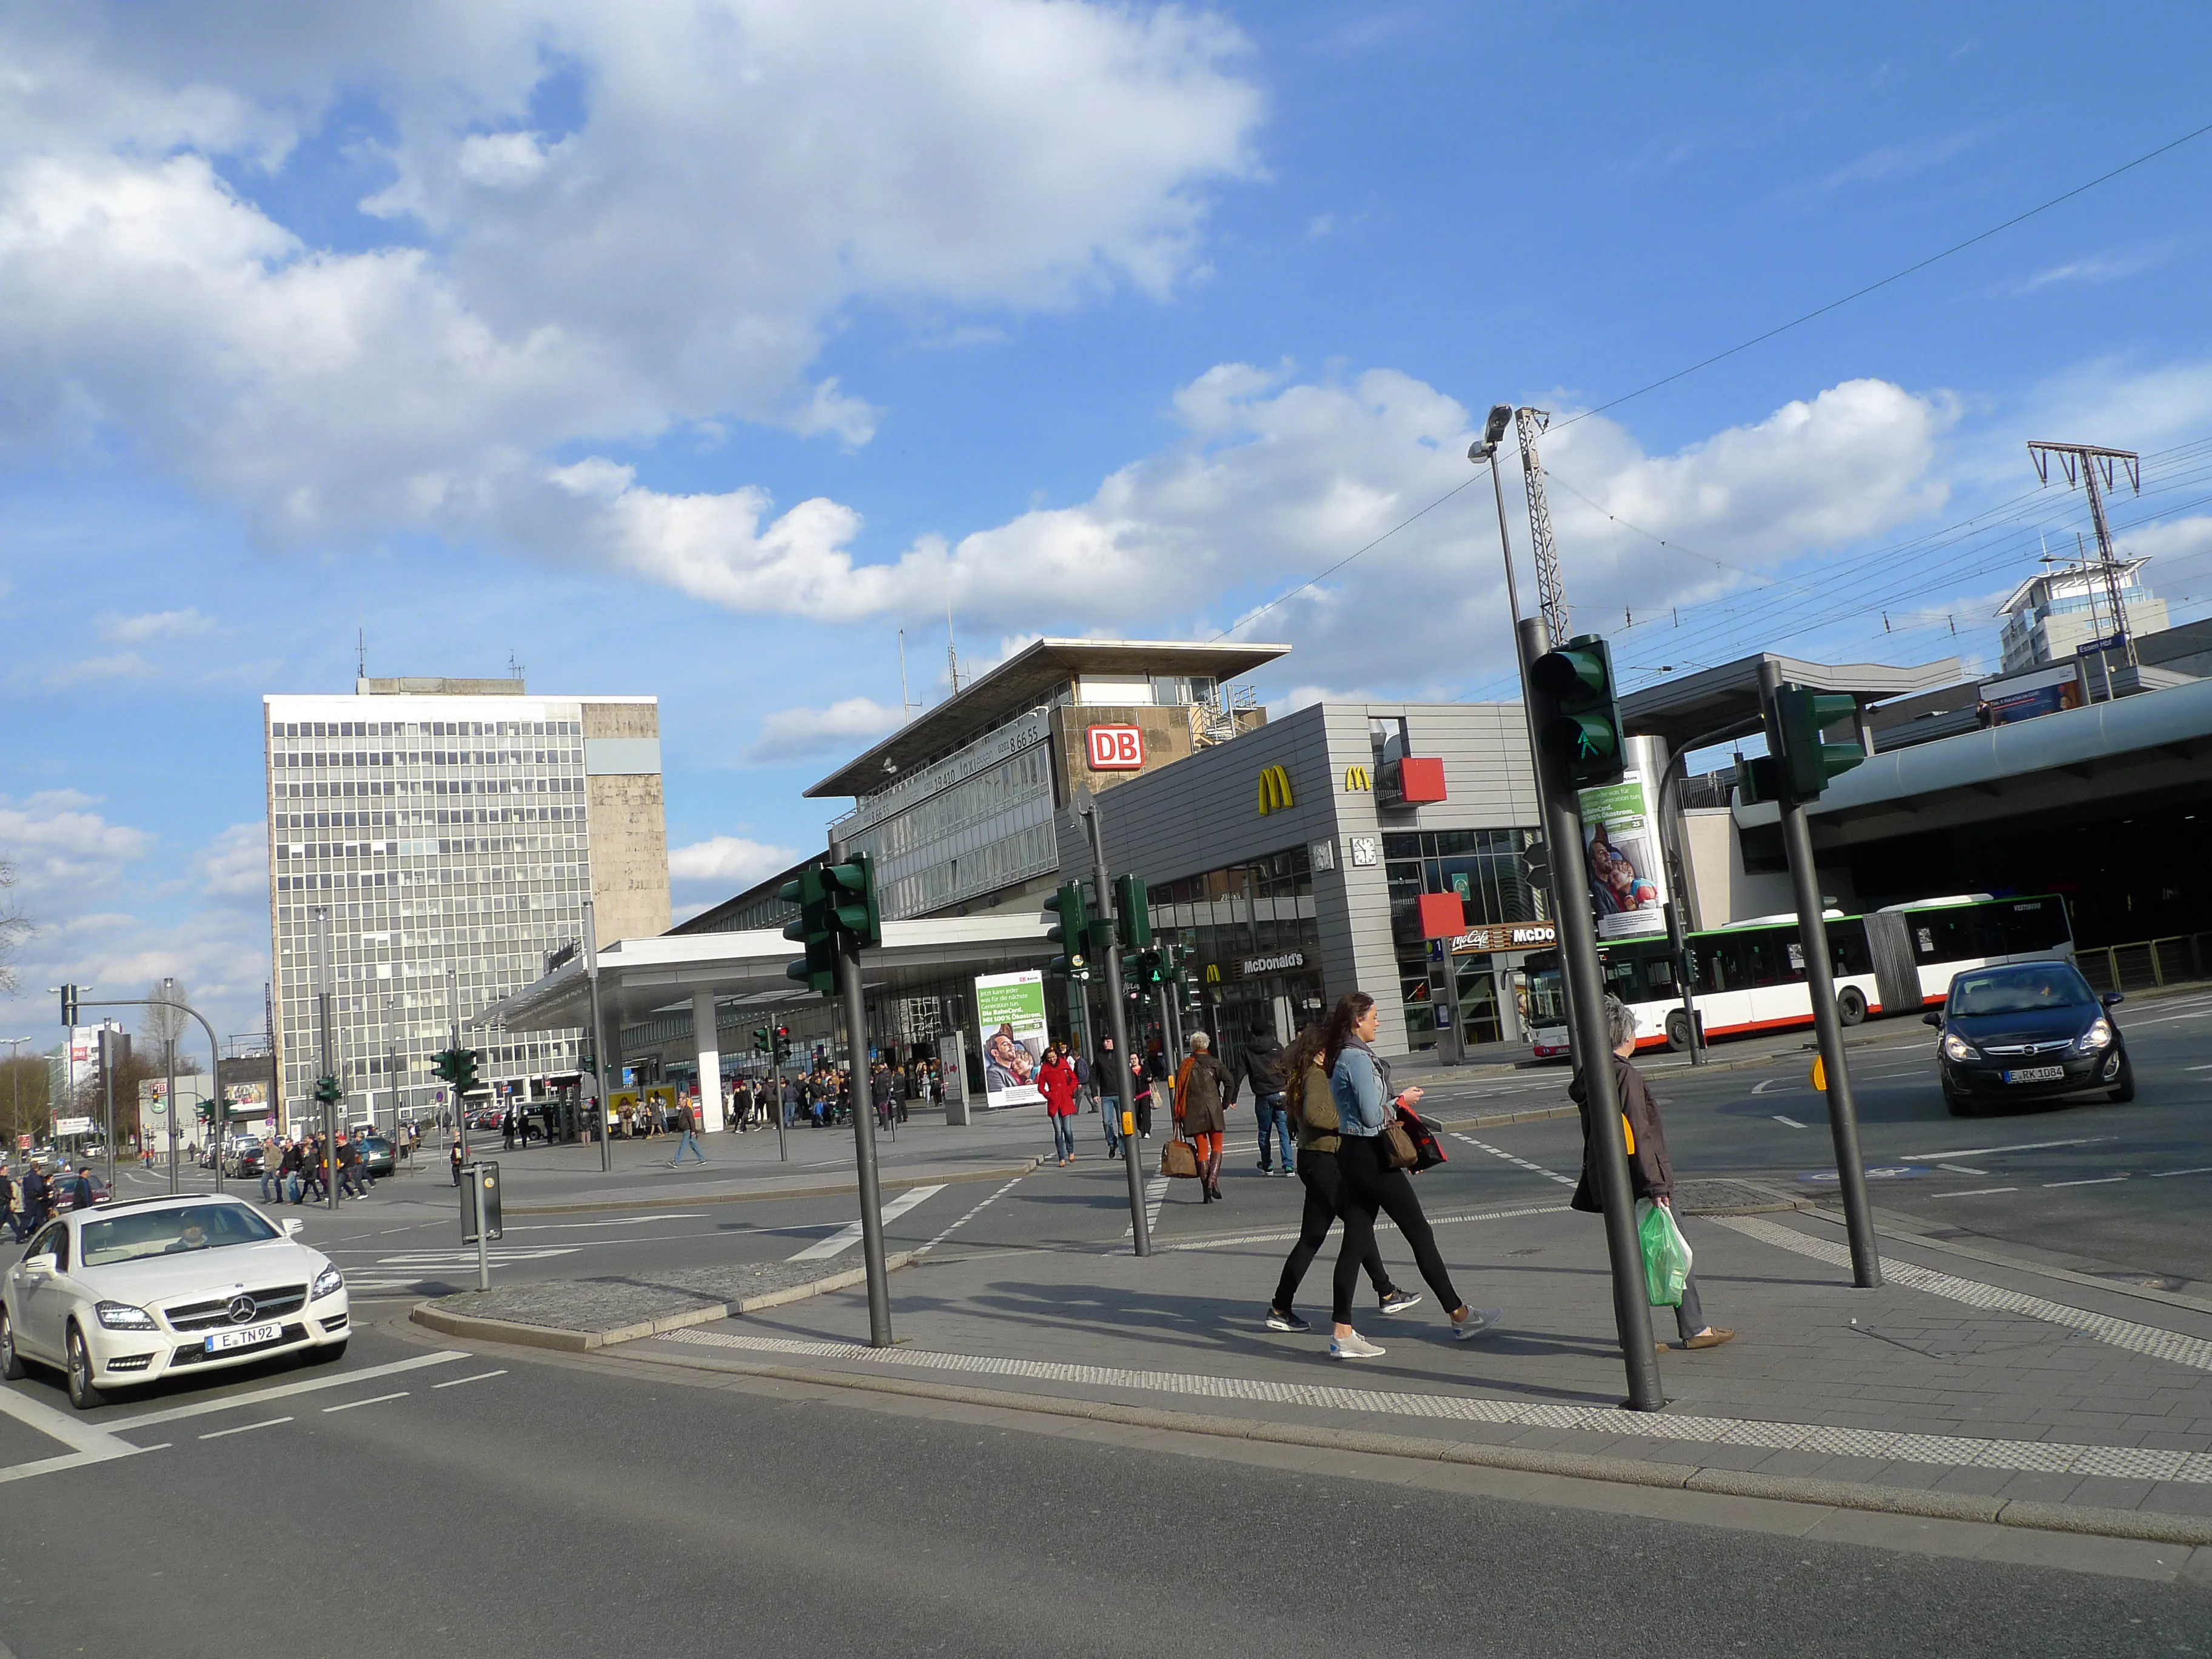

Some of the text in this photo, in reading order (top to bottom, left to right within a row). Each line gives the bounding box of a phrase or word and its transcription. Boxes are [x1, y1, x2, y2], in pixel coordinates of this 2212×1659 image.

[2079, 638, 2112, 653] Essen Hbf
[1096, 731, 1137, 762] DB
[1601, 809, 1635, 818] Ökostrom.
[1436, 940, 1441, 951] 1
[1452, 930, 1490, 951] McCafé
[1244, 952, 1304, 974] McDonald's
[1005, 987, 1019, 996] jeder
[993, 1006, 1024, 1015] BahnCard.
[2023, 1070, 2036, 1079] RK
[2038, 1067, 2062, 1078] 1084
[223, 1335, 231, 1347] E
